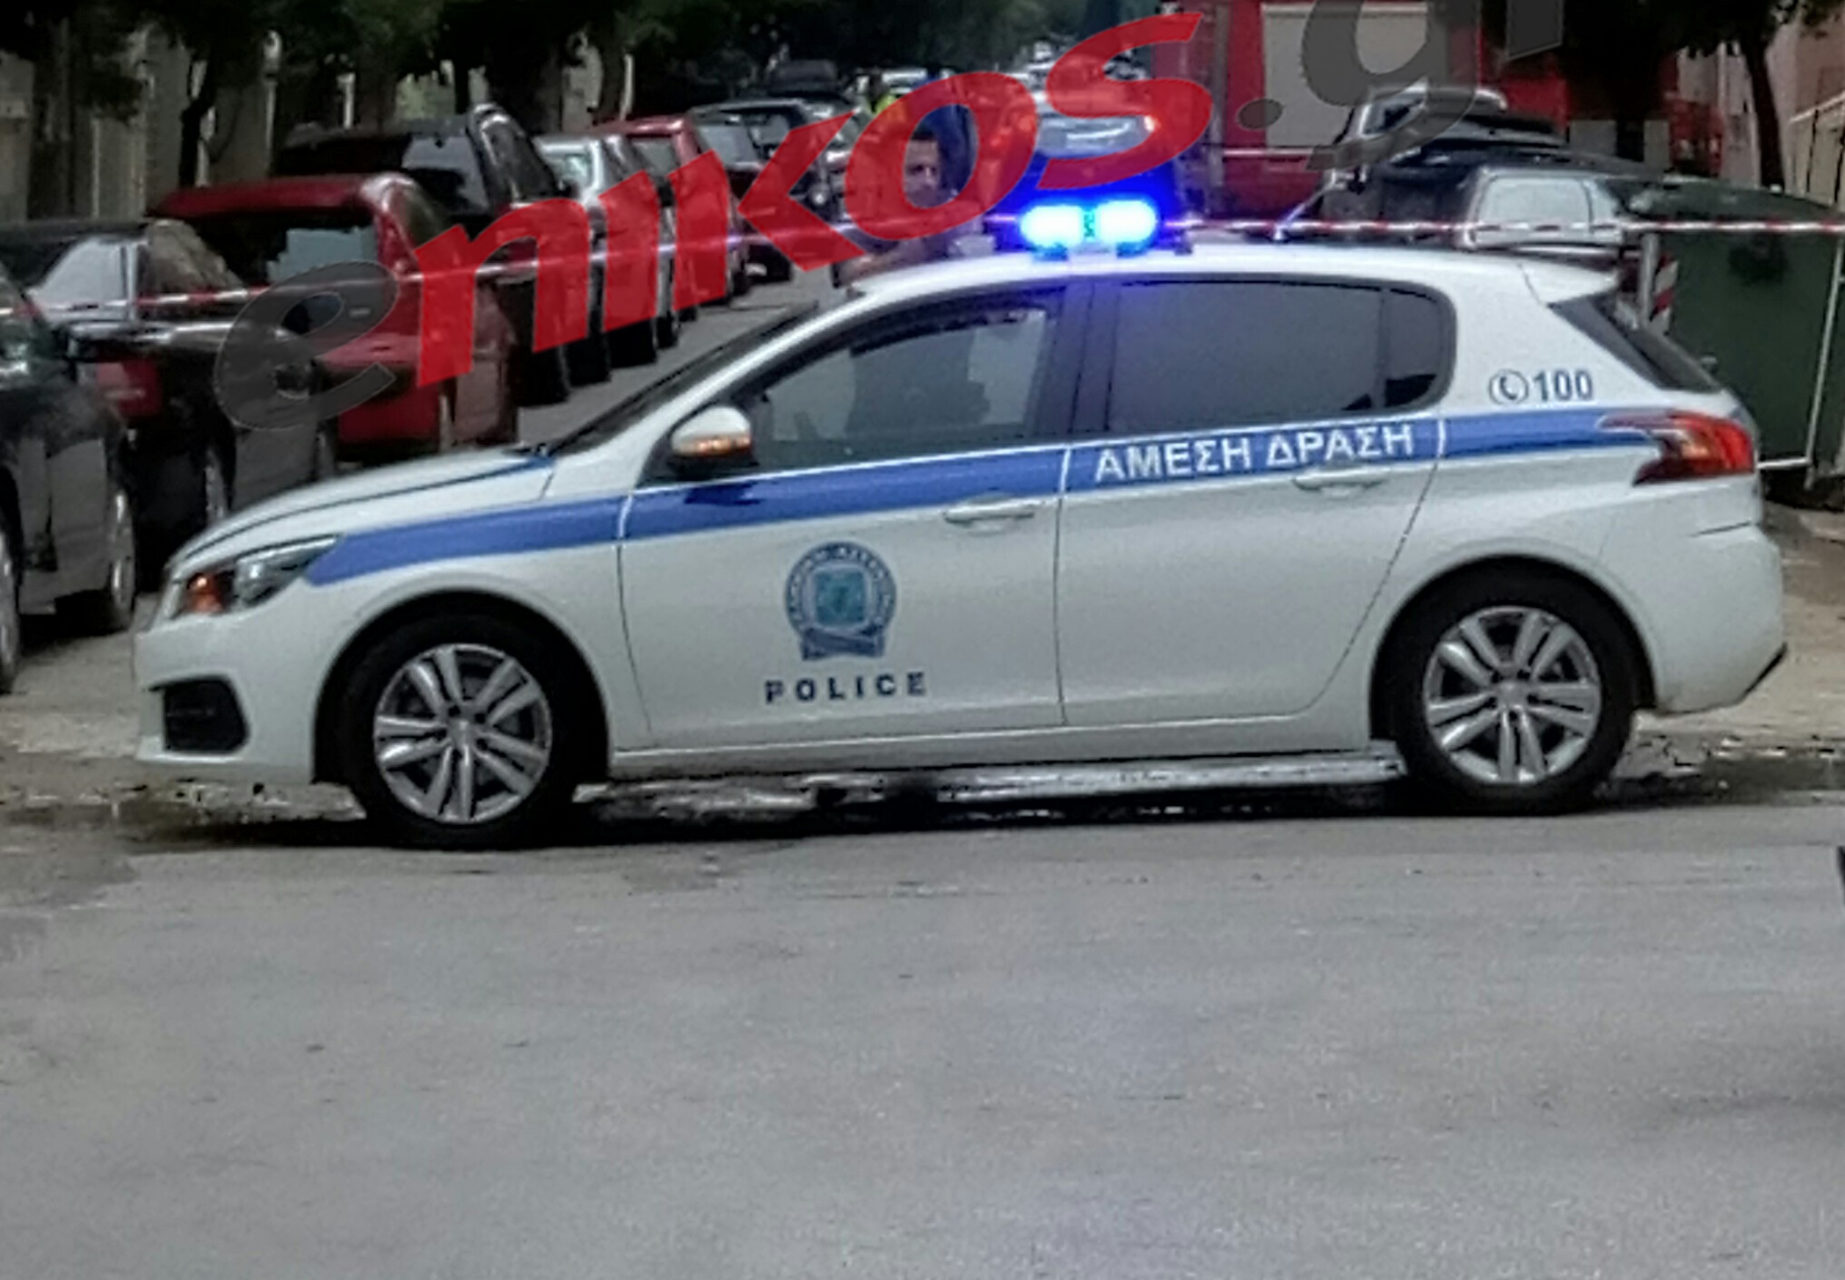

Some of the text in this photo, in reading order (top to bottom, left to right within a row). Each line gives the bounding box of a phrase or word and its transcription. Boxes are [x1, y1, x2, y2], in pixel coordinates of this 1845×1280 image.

[1532, 368, 1594, 403] 100
[1094, 424, 1415, 483] ΑΜΕΣΗ ΔΡΑΣΗ
[764, 671, 927, 705] POLICE
